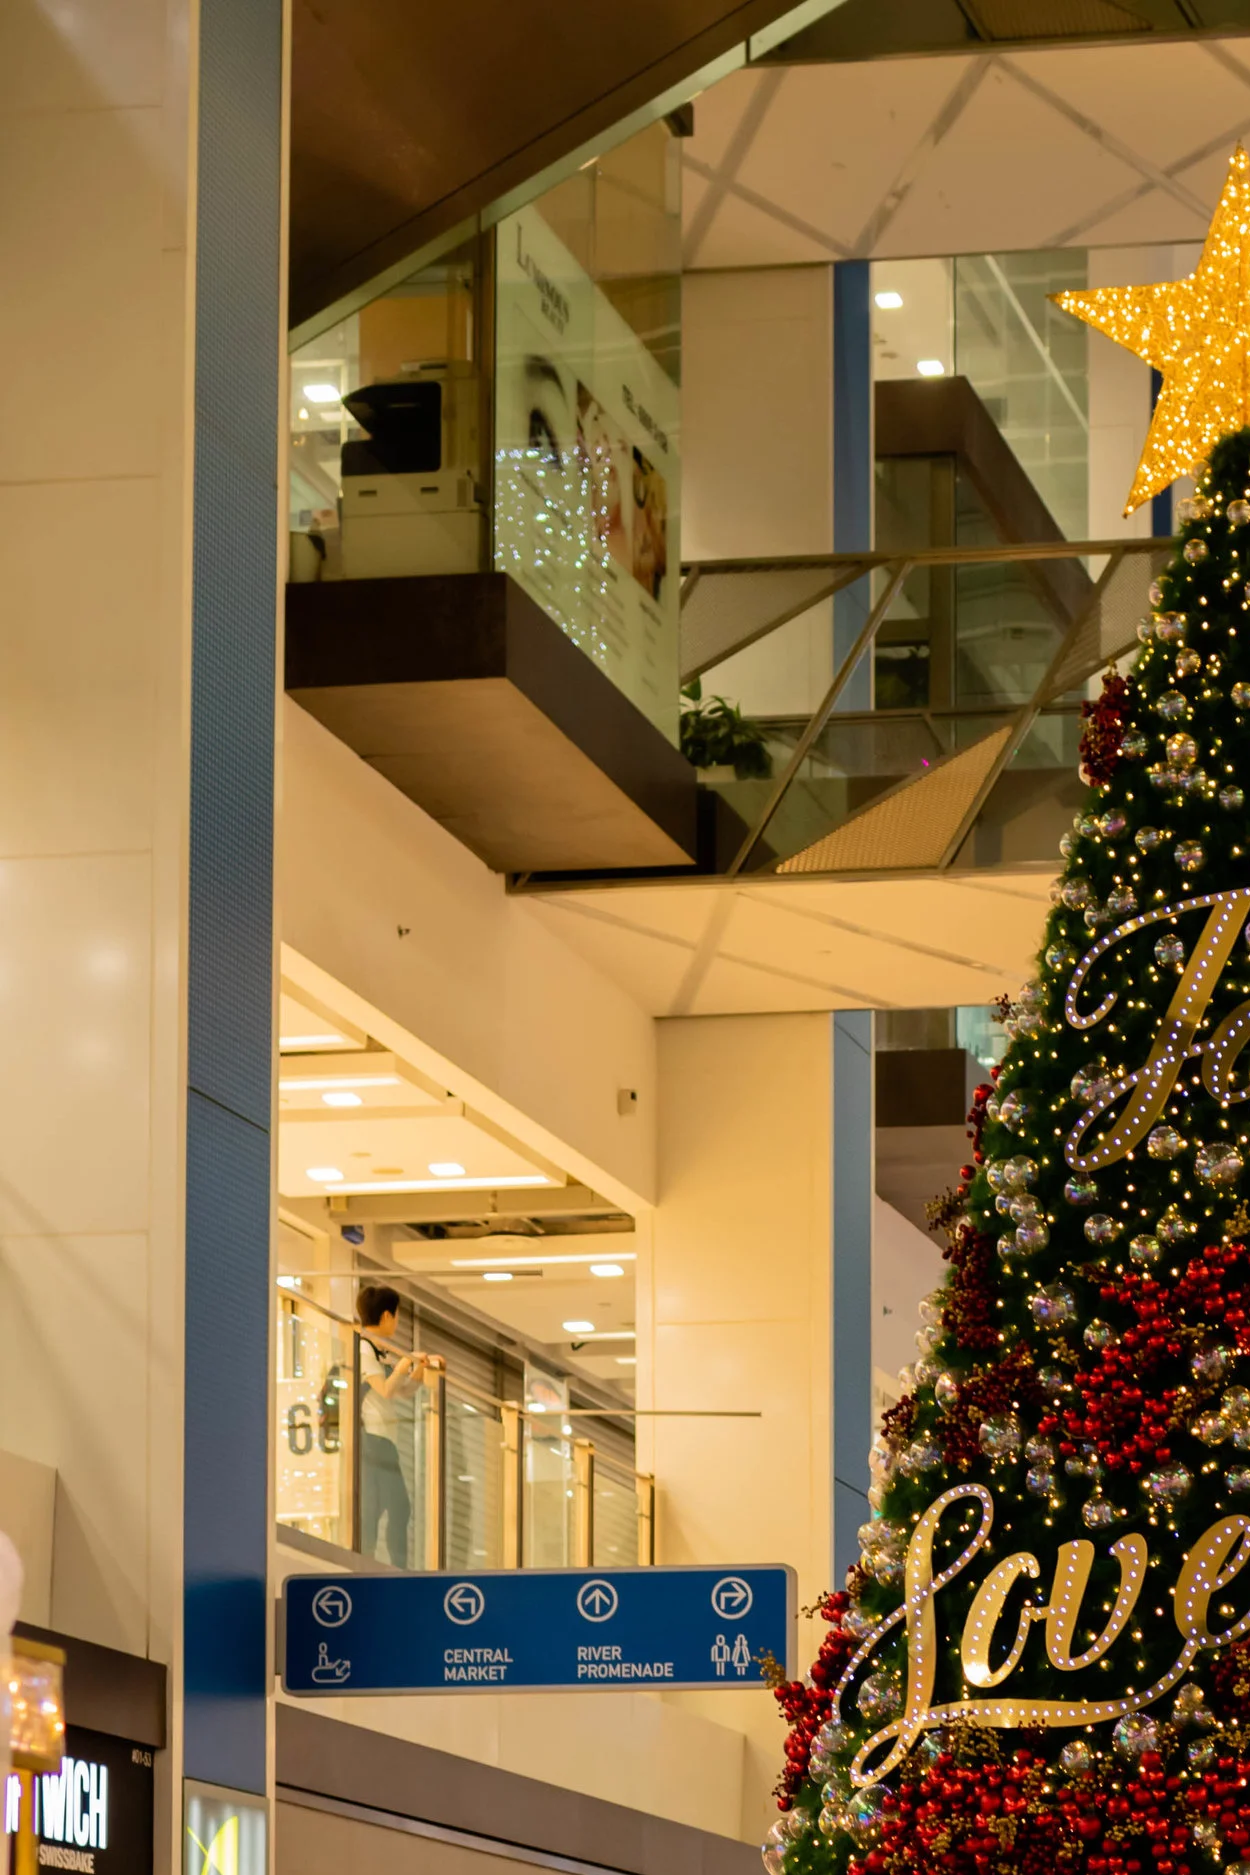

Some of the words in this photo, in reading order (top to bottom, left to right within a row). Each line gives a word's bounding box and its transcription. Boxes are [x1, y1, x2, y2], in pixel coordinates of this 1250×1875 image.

[443, 1648, 513, 1663] CENTRAL
[577, 1646, 622, 1661] RIVER
[444, 1665, 508, 1681] MARKET
[577, 1662, 674, 1679] PROMENADE
[38, 1843, 95, 1875] SWISSBAKE
